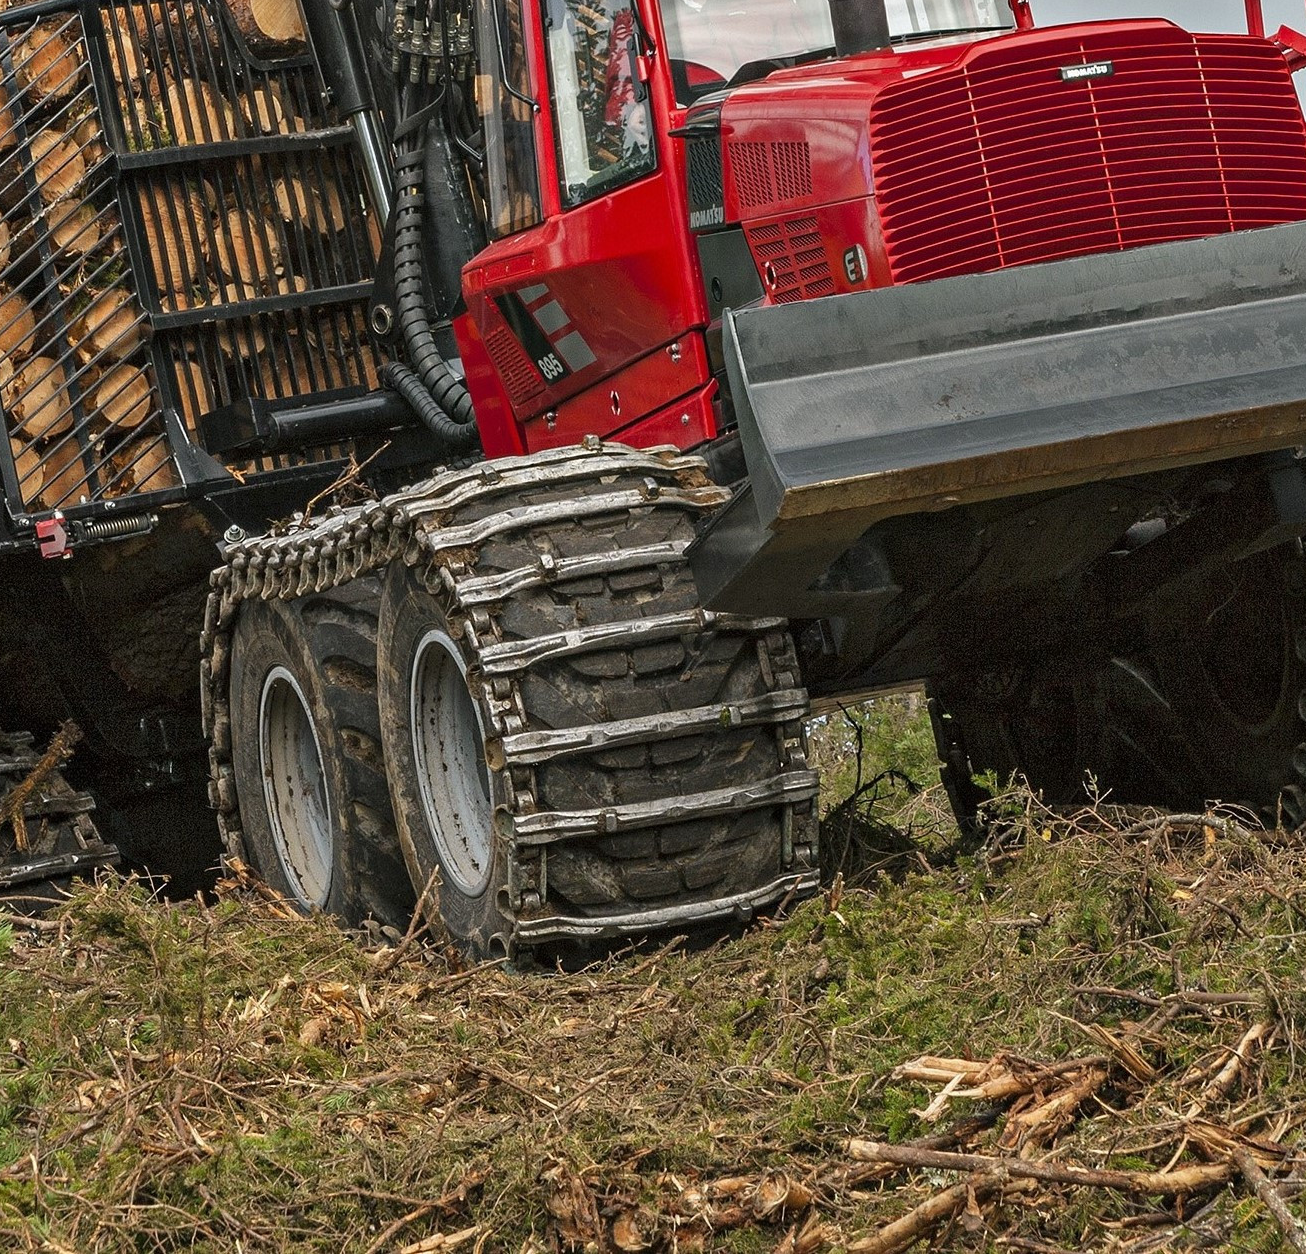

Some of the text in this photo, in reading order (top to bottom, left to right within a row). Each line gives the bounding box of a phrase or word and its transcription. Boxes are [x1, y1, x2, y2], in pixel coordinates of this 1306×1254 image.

[1066, 64, 1108, 78] KOMATSU
[690, 203, 724, 228] KOMATSU
[537, 352, 564, 380] 895
